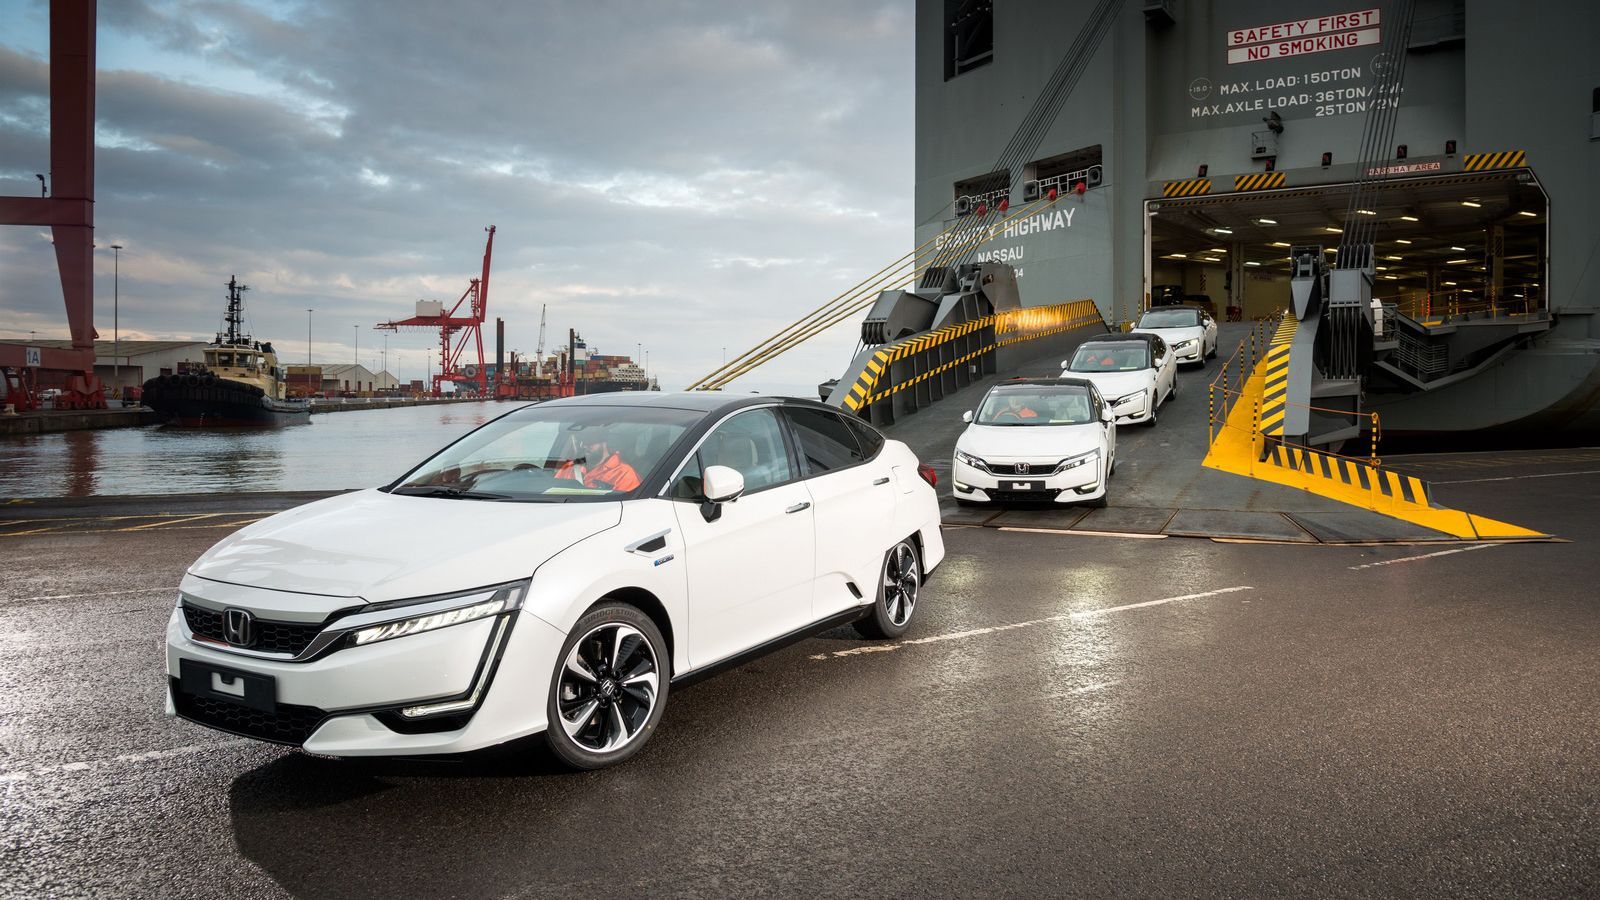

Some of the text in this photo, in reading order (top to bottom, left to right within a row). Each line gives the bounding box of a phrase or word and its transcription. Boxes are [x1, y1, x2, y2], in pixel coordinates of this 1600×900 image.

[1233, 11, 1373, 44] SAFETY FIRST
[1247, 33, 1358, 60] NO SMOKING
[1393, 165, 1411, 173] HAT
[1415, 162, 1440, 171] AREA
[1004, 207, 1076, 239] HIGHWAY
[977, 245, 1024, 264] NASSAU
[28, 351, 39, 364] 1A
